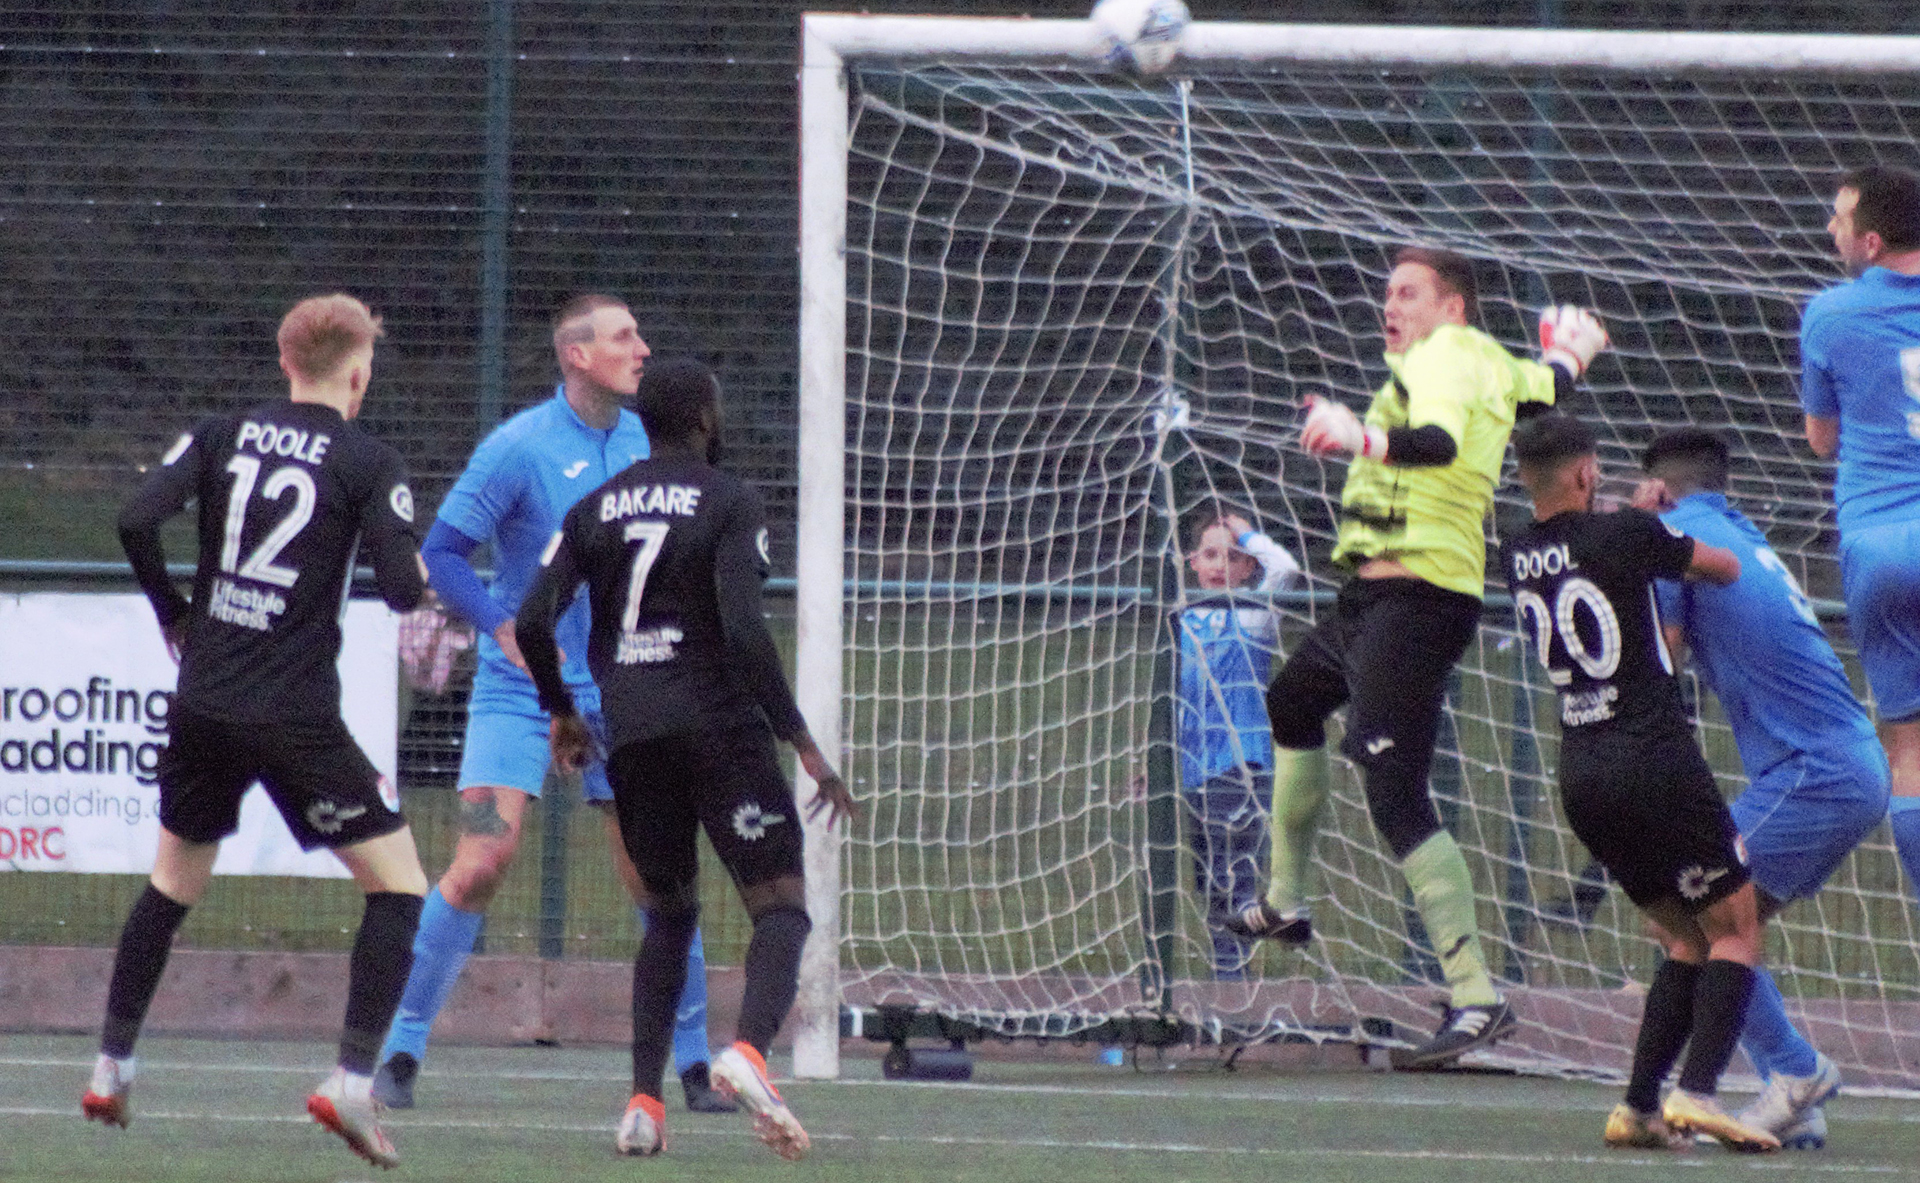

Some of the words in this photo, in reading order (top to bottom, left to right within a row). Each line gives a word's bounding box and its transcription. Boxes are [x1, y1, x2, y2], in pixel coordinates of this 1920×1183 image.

[237, 420, 331, 465] POOLE
[220, 453, 317, 588] 12
[601, 484, 702, 523] BAKARE
[623, 520, 670, 634] 7
[1515, 576, 1622, 686] 20
[3, 676, 177, 735] roofing
